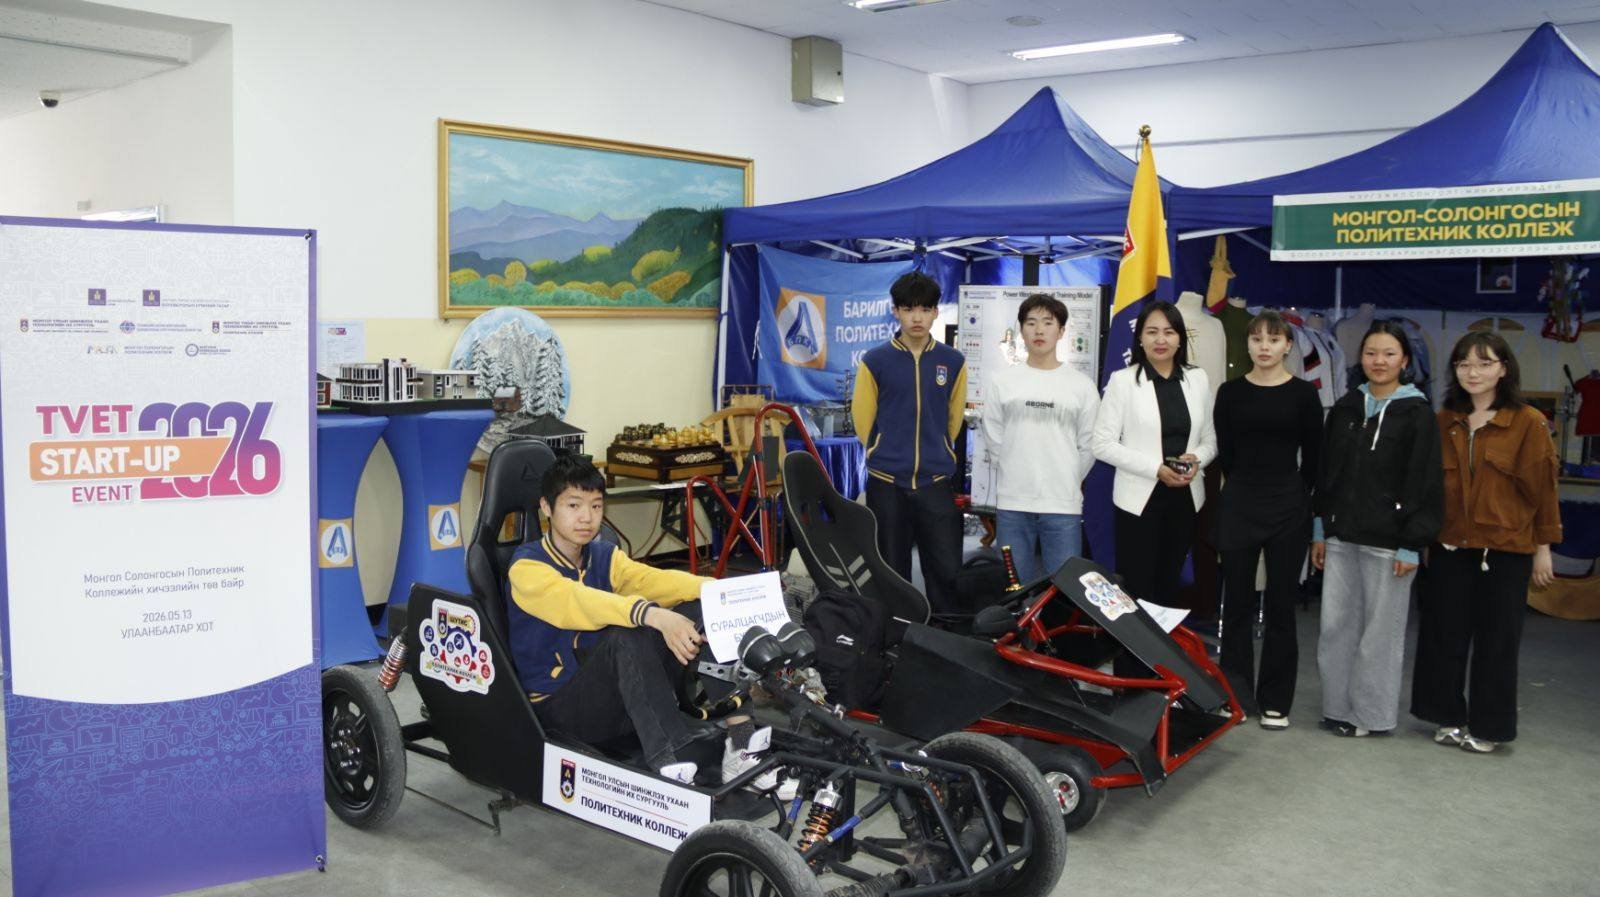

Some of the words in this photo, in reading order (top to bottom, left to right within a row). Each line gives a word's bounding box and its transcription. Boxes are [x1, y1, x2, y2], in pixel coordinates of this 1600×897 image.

[1332, 201, 1581, 227] МОНГОЛ-СОЛОНГОСЫН
[1336, 223, 1473, 244] ПОЛИТЕХНИК
[1476, 220, 1574, 239] КОЛЛЕЖ
[36, 404, 133, 435] TVET
[40, 445, 180, 476] START-UP
[138, 401, 281, 500] 2026
[72, 485, 133, 503] EVENT
[83, 573, 122, 584] Монгол
[124, 570, 185, 582] Солонгосын
[187, 564, 245, 577] Политехник
[85, 585, 144, 598] Коллежийн
[146, 581, 199, 594] хичээлийн
[221, 577, 245, 590] байр
[142, 609, 193, 623] 2026.05.13
[710, 610, 786, 633] СУРАЛЦАГЧДЫН
[121, 623, 194, 639] УЛААНБААТАР
[196, 621, 214, 632] ХОТ
[581, 767, 607, 781] МОНГОЛ
[608, 775, 630, 788] УЛСЫН
[631, 782, 665, 802] ШИНЖЛЭХ
[666, 795, 689, 809] УХААН
[581, 775, 626, 796] ТЕХНОЛОГИЙН
[626, 790, 635, 799] ИХ
[636, 793, 669, 811] СУРГУУЛЬ
[581, 796, 643, 826] ПОЛИТЕХНИК
[645, 818, 688, 841] КОЛЛЕЖ
